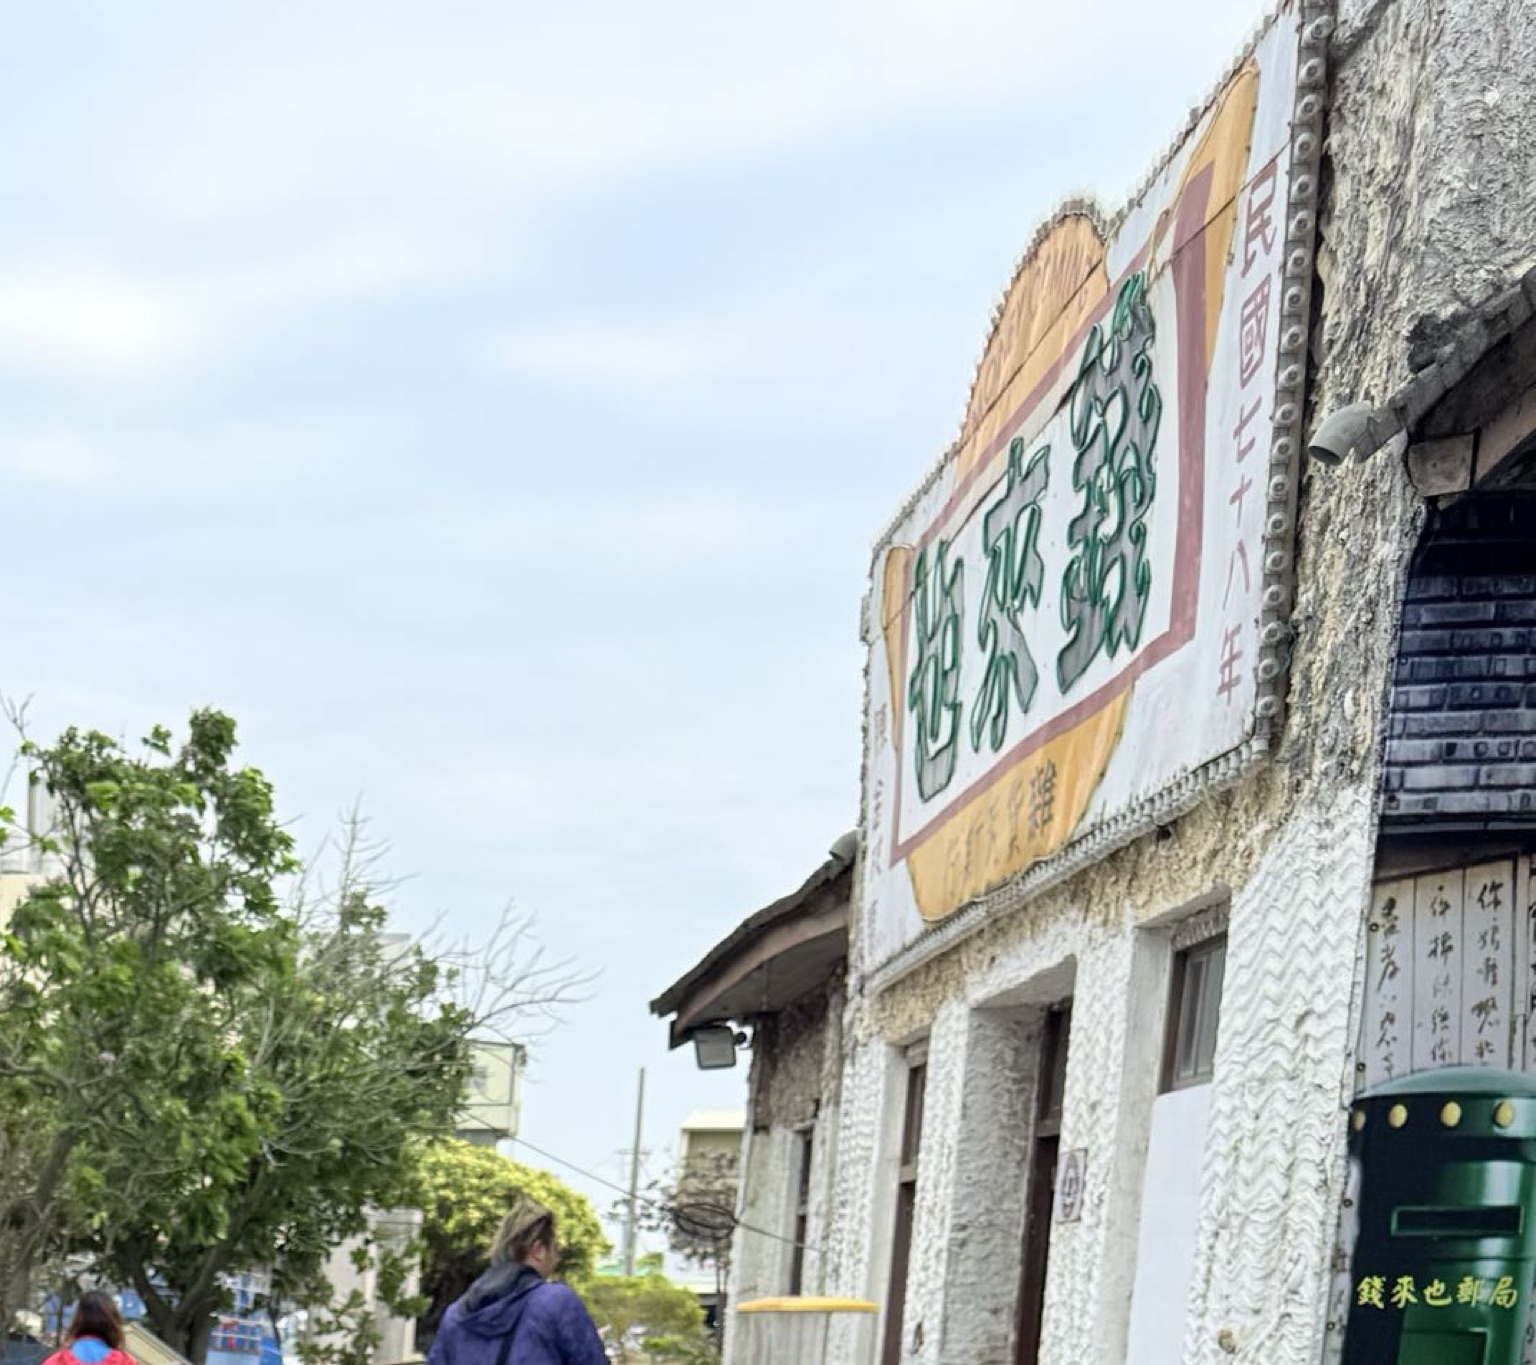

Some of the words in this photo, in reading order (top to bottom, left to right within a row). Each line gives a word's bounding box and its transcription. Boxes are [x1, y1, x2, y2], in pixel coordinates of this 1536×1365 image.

[1217, 159, 1277, 701] 民國七十八年
[1356, 1276, 1517, 1310] 錢來也郵局
